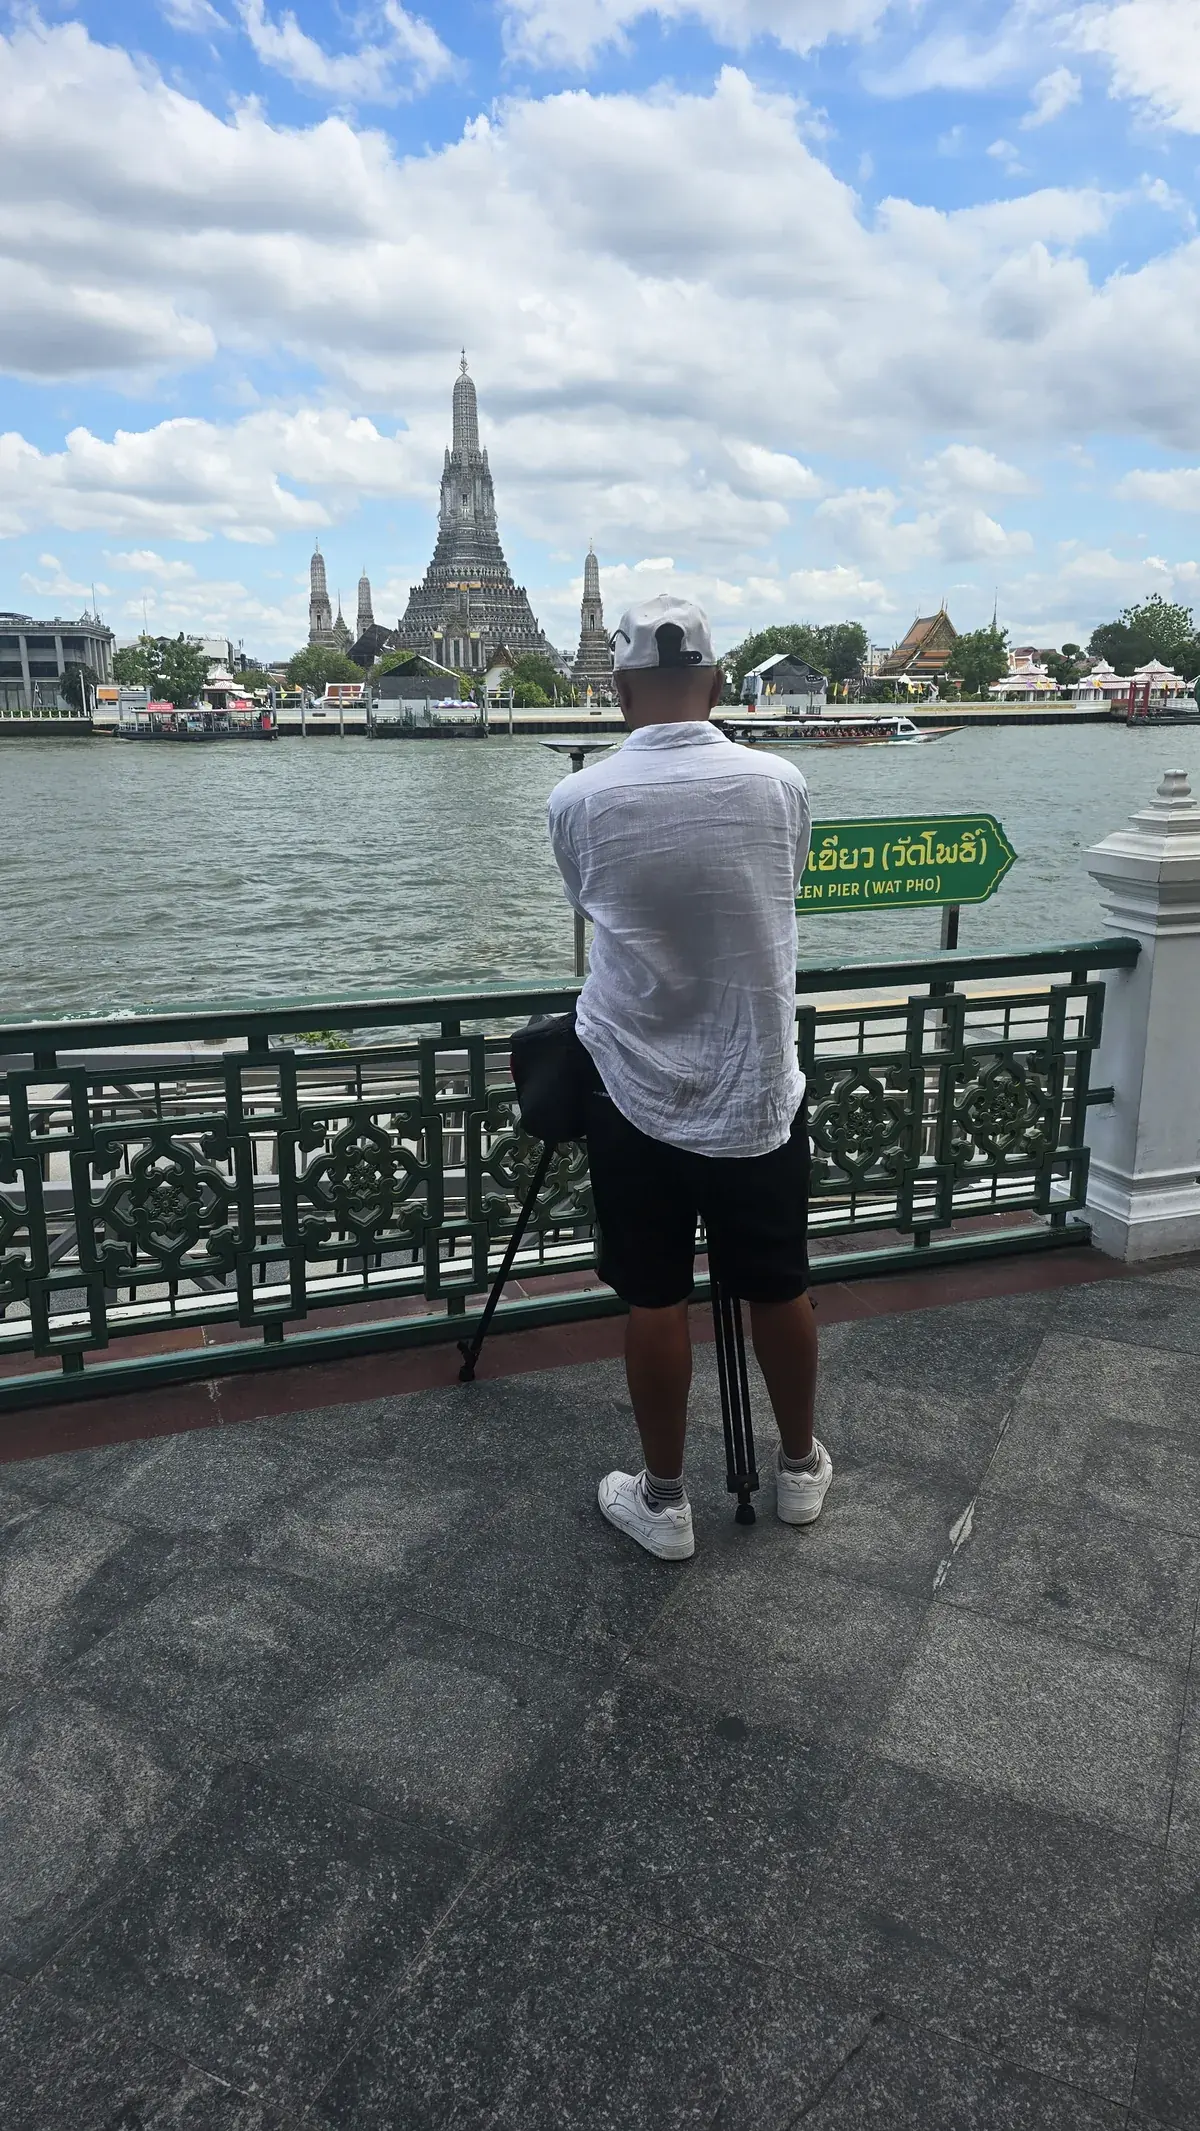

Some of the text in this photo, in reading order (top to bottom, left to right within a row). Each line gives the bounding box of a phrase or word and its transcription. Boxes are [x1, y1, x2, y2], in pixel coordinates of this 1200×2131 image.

[882, 827, 987, 871] (วัดโพธิ์)
[828, 882, 860, 897] PIER
[864, 879, 902, 898] (WAT
[906, 875, 941, 894] PHO)
